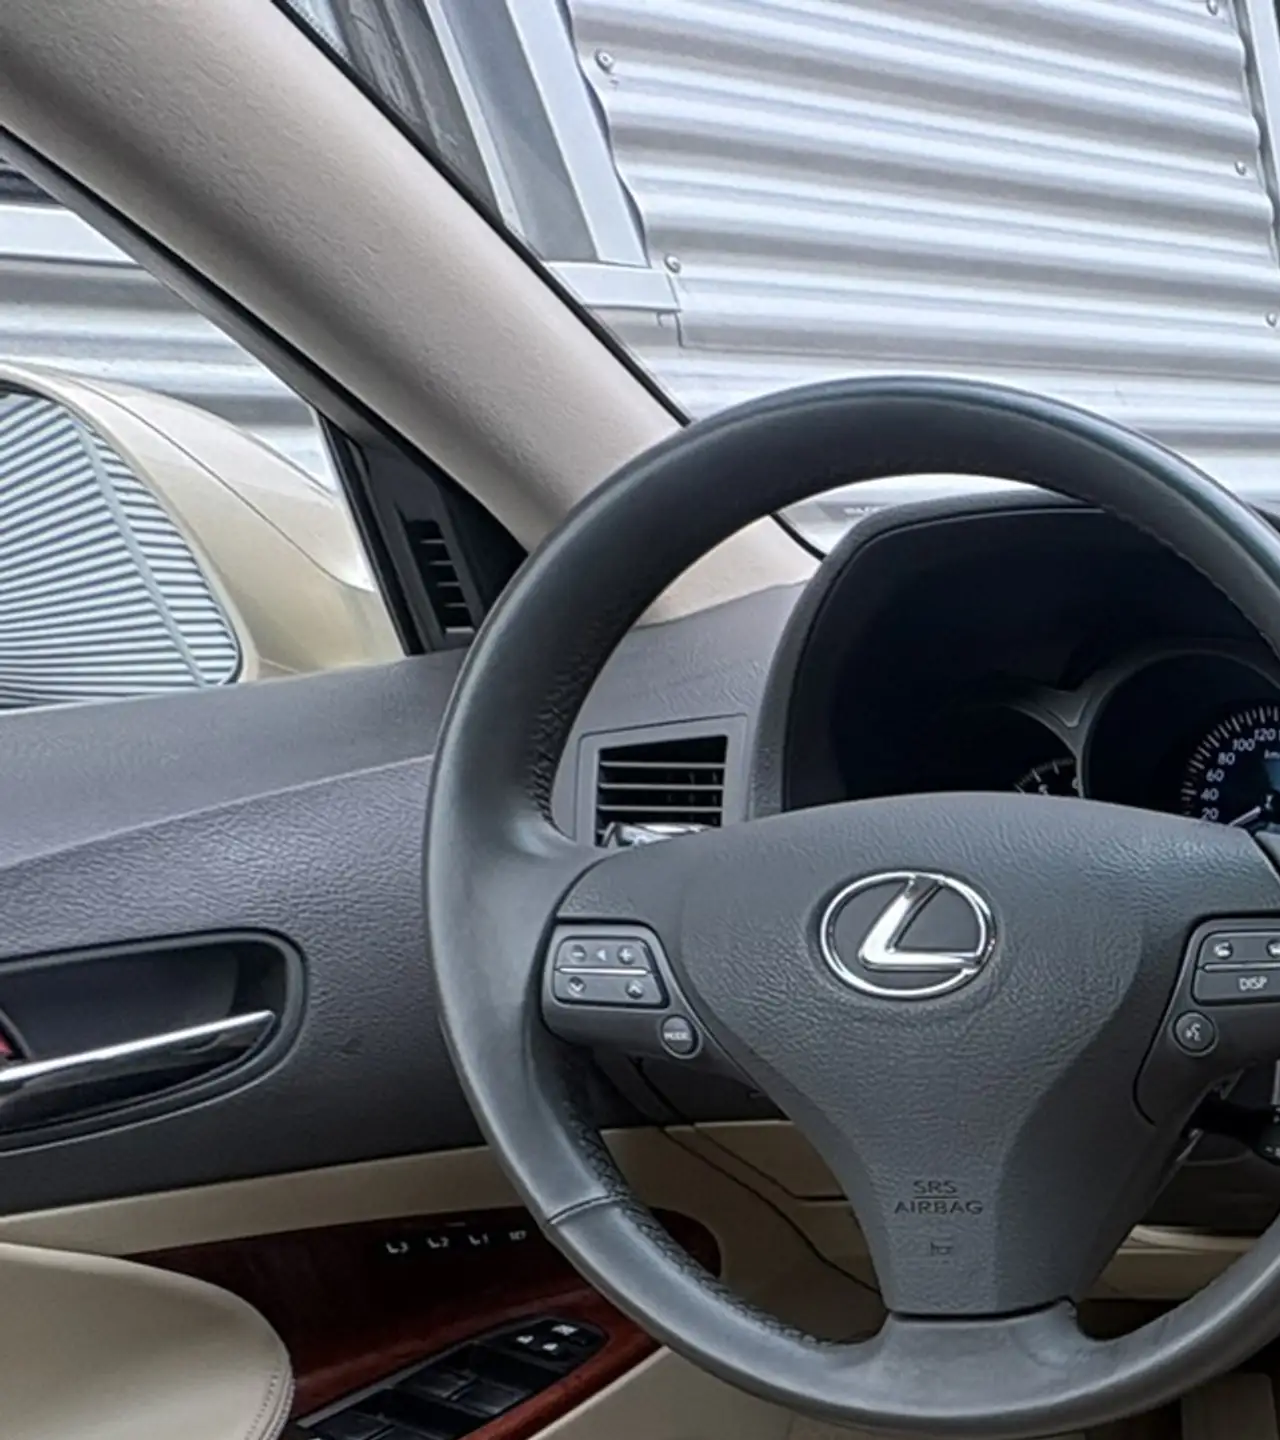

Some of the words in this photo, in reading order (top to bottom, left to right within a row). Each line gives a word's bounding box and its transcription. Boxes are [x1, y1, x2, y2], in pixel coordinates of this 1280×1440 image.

[1255, 728, 1276, 741] 120
[1233, 739, 1255, 751] 100
[1218, 752, 1235, 765] 80
[1206, 769, 1225, 782] 60
[1201, 788, 1219, 801] 40
[1202, 808, 1219, 821] 20
[1239, 976, 1267, 991] DISP
[913, 1180, 958, 1194] SRS
[894, 1200, 984, 1214] AIRBAG
